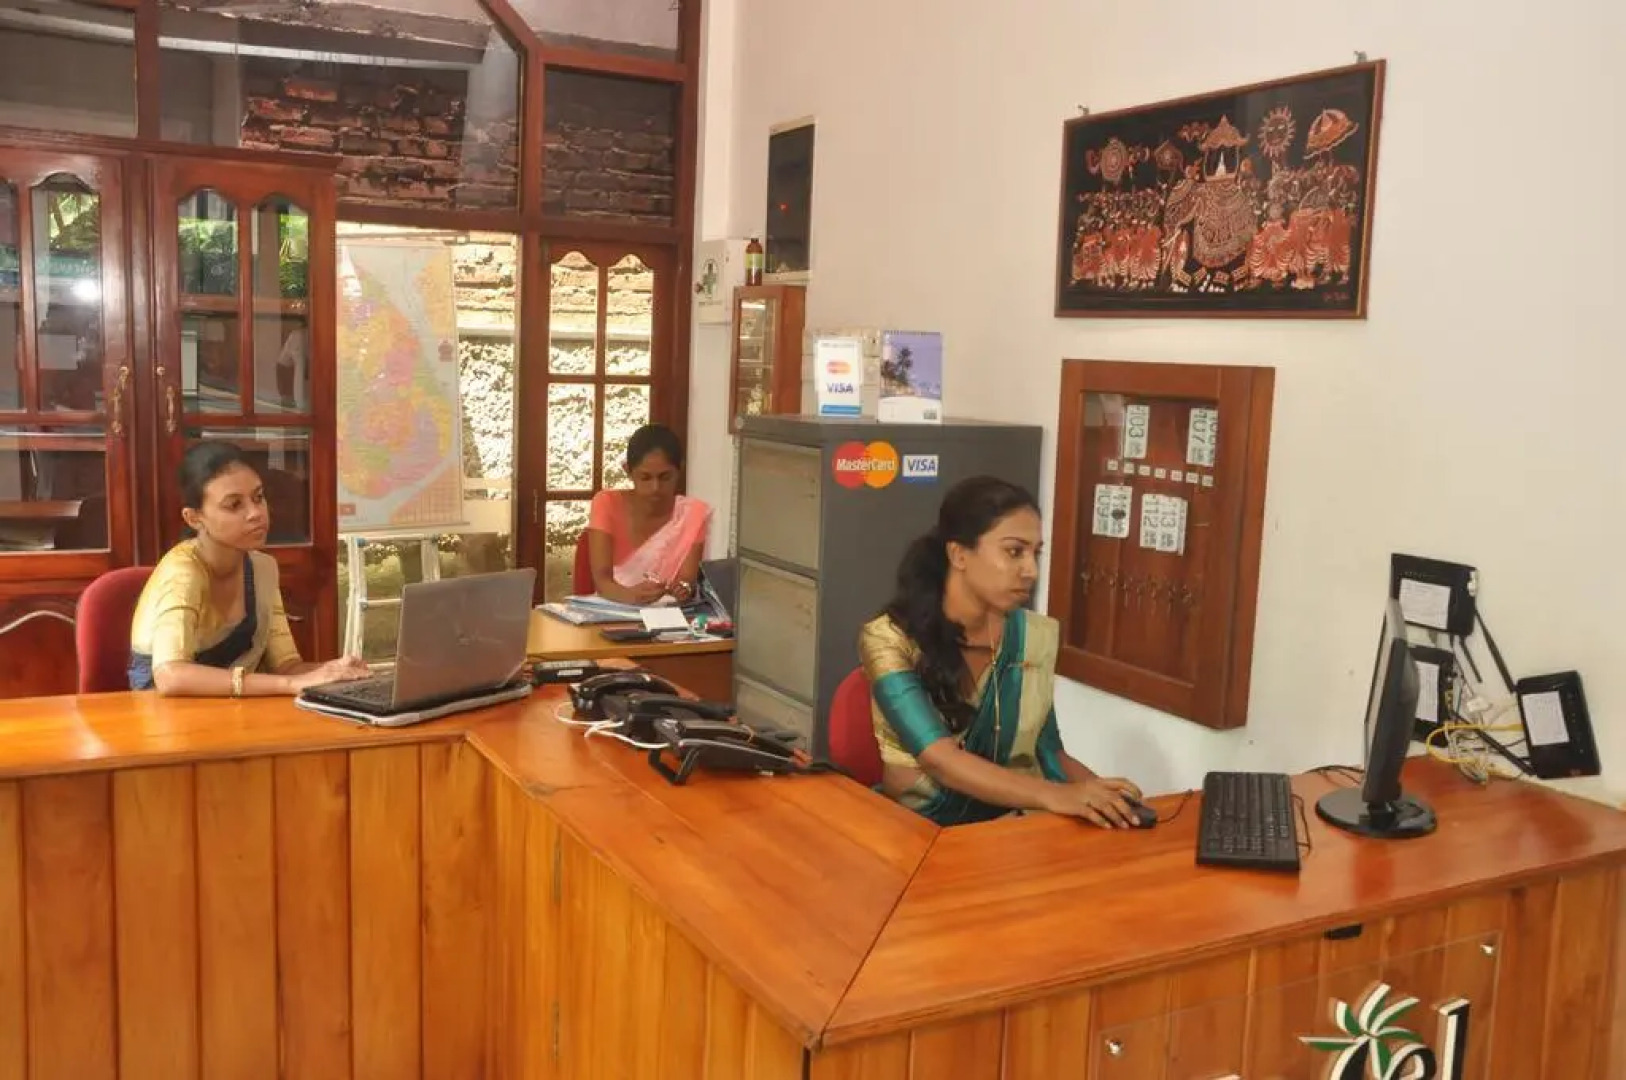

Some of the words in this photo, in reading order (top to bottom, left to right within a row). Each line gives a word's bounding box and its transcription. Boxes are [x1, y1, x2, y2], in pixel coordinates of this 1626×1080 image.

[827, 382, 854, 394] VISA
[836, 457, 895, 472] MasterCard
[907, 458, 936, 473] VISA
